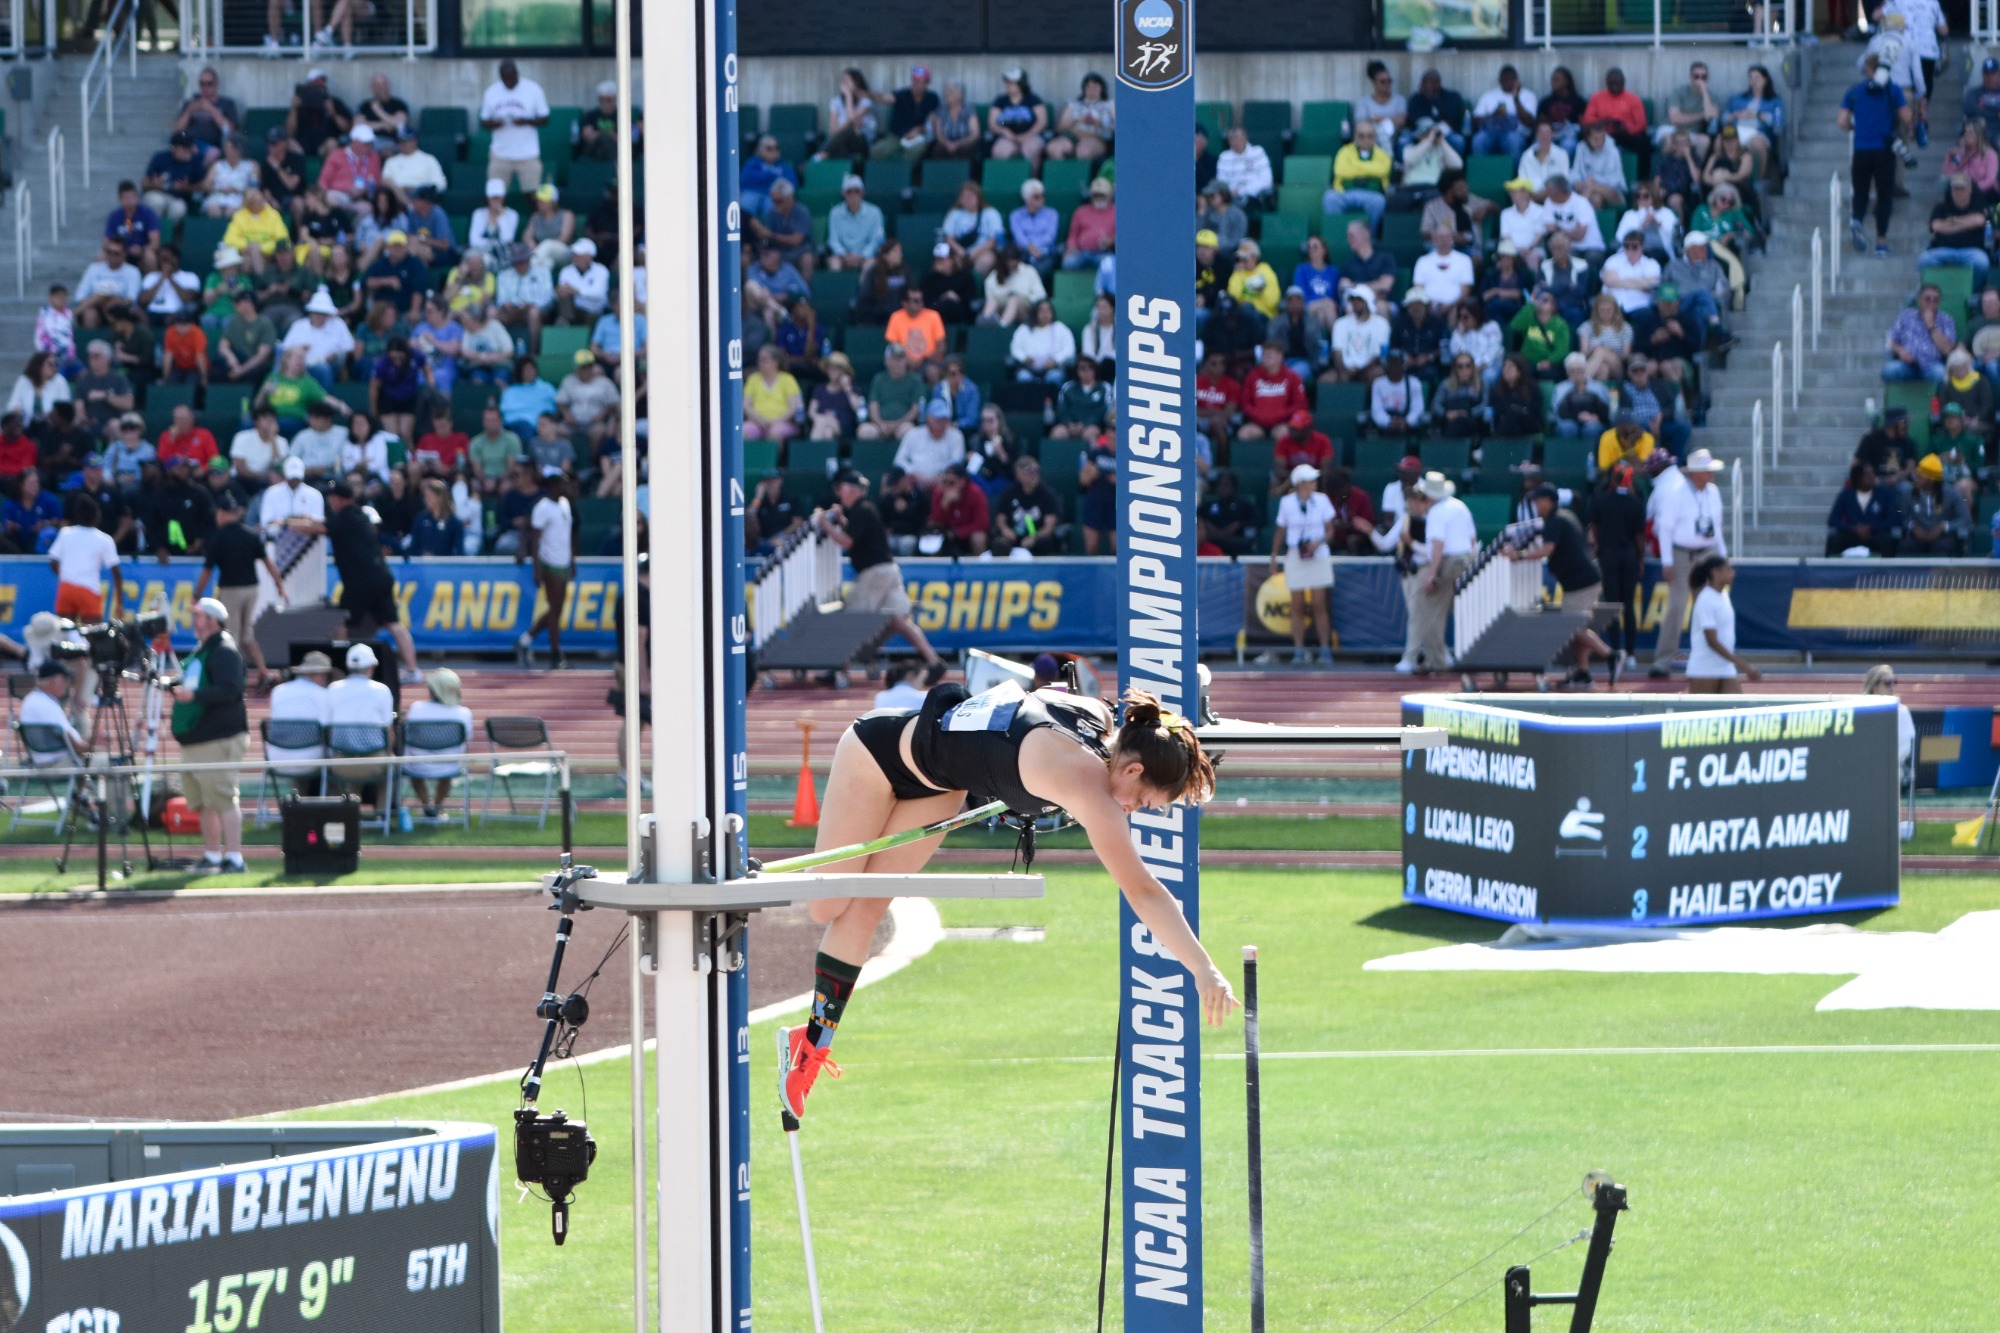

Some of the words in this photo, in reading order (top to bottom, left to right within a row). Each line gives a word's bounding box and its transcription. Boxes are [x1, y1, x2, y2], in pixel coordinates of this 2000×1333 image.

[1138, 16, 1173, 28] NCAA
[1128, 294, 1182, 716] HAMPIONSHIPS
[422, 580, 522, 631] AND
[1661, 717, 1732, 749] WOMEN
[1733, 712, 1783, 744] LONG
[1782, 709, 1834, 740] JUMP
[1833, 707, 1855, 736] F1
[1489, 751, 1537, 792] HAVEA
[1631, 757, 1647, 793] 1
[1667, 755, 1692, 791] F.
[1698, 746, 1810, 788] OLAJIDE
[1474, 814, 1515, 854] LEKO
[1631, 825, 1649, 860] 2
[1668, 816, 1761, 858] MARTA
[1765, 808, 1850, 849] AMANI
[1424, 867, 1474, 908] CIERRA
[1473, 876, 1538, 920] JACKSON
[1631, 887, 1649, 922] 3
[1668, 878, 1767, 919] HAILEY
[1768, 871, 1842, 910] COEY
[1131, 965, 1186, 1139] TRACK
[61, 1177, 221, 1261] MARIA
[231, 1141, 461, 1233] BIENVENU
[1134, 1166, 1188, 1306] NCAA
[406, 1242, 469, 1293] 5TH
